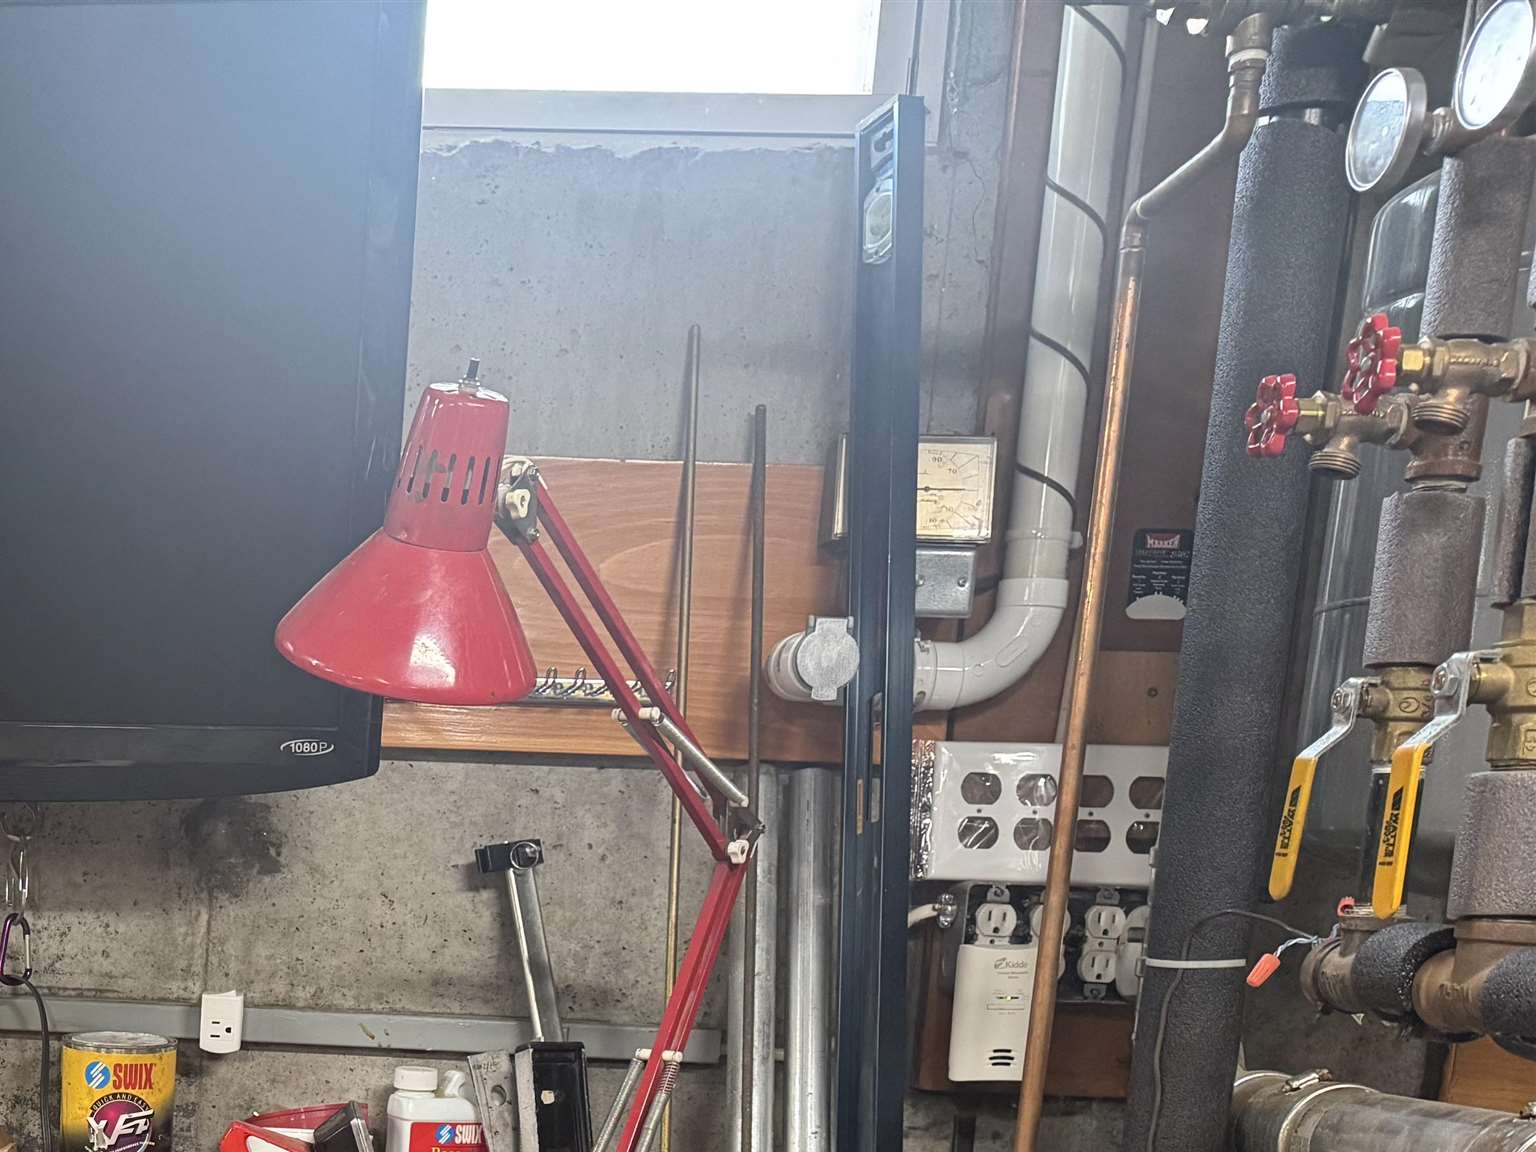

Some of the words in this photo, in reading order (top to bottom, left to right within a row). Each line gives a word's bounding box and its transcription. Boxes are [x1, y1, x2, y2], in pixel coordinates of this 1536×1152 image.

[289, 741, 328, 753] 1080P
[112, 1063, 154, 1090] SWIX
[92, 1096, 114, 1112] QUICK
[116, 1093, 131, 1101] AND
[455, 1124, 482, 1145] SWIX
